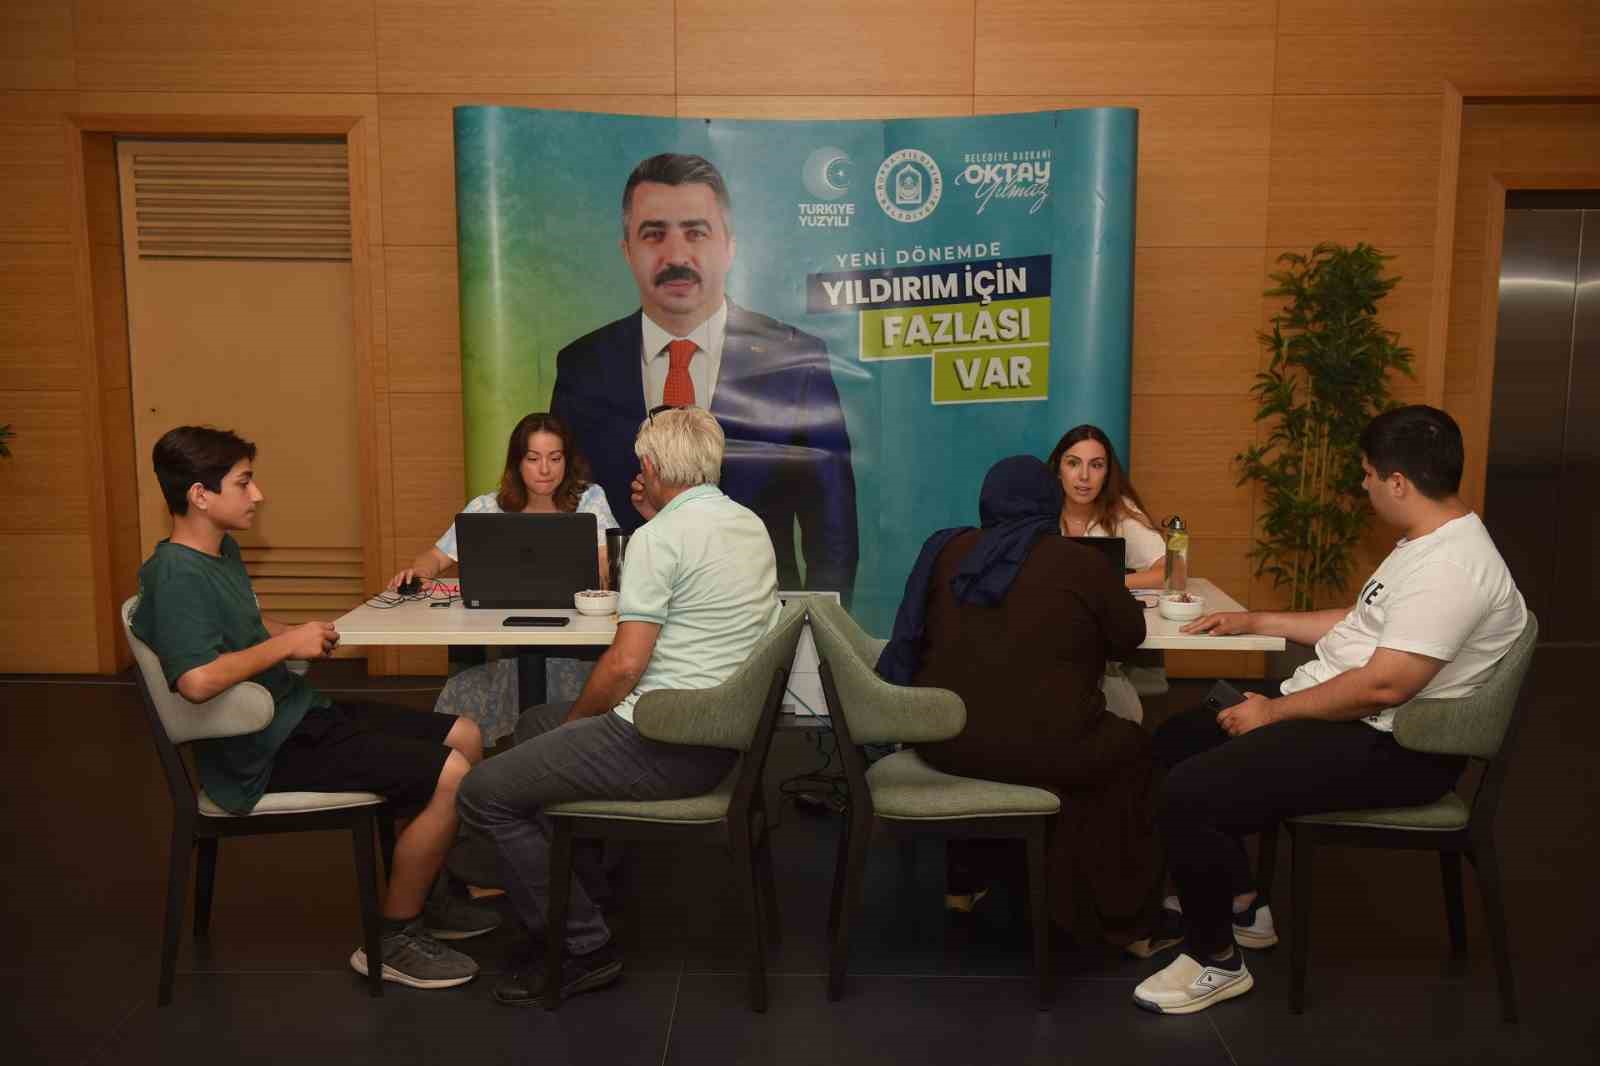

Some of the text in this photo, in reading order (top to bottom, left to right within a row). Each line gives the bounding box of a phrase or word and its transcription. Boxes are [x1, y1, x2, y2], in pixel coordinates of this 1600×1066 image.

[955, 161, 1051, 184] OKTAY
[836, 242, 1001, 268] YENİ DÖNEMDE
[822, 262, 1027, 305] YILDIRIM İÇİN
[883, 307, 1031, 347] FAZLASI
[954, 355, 1033, 390] VAR
